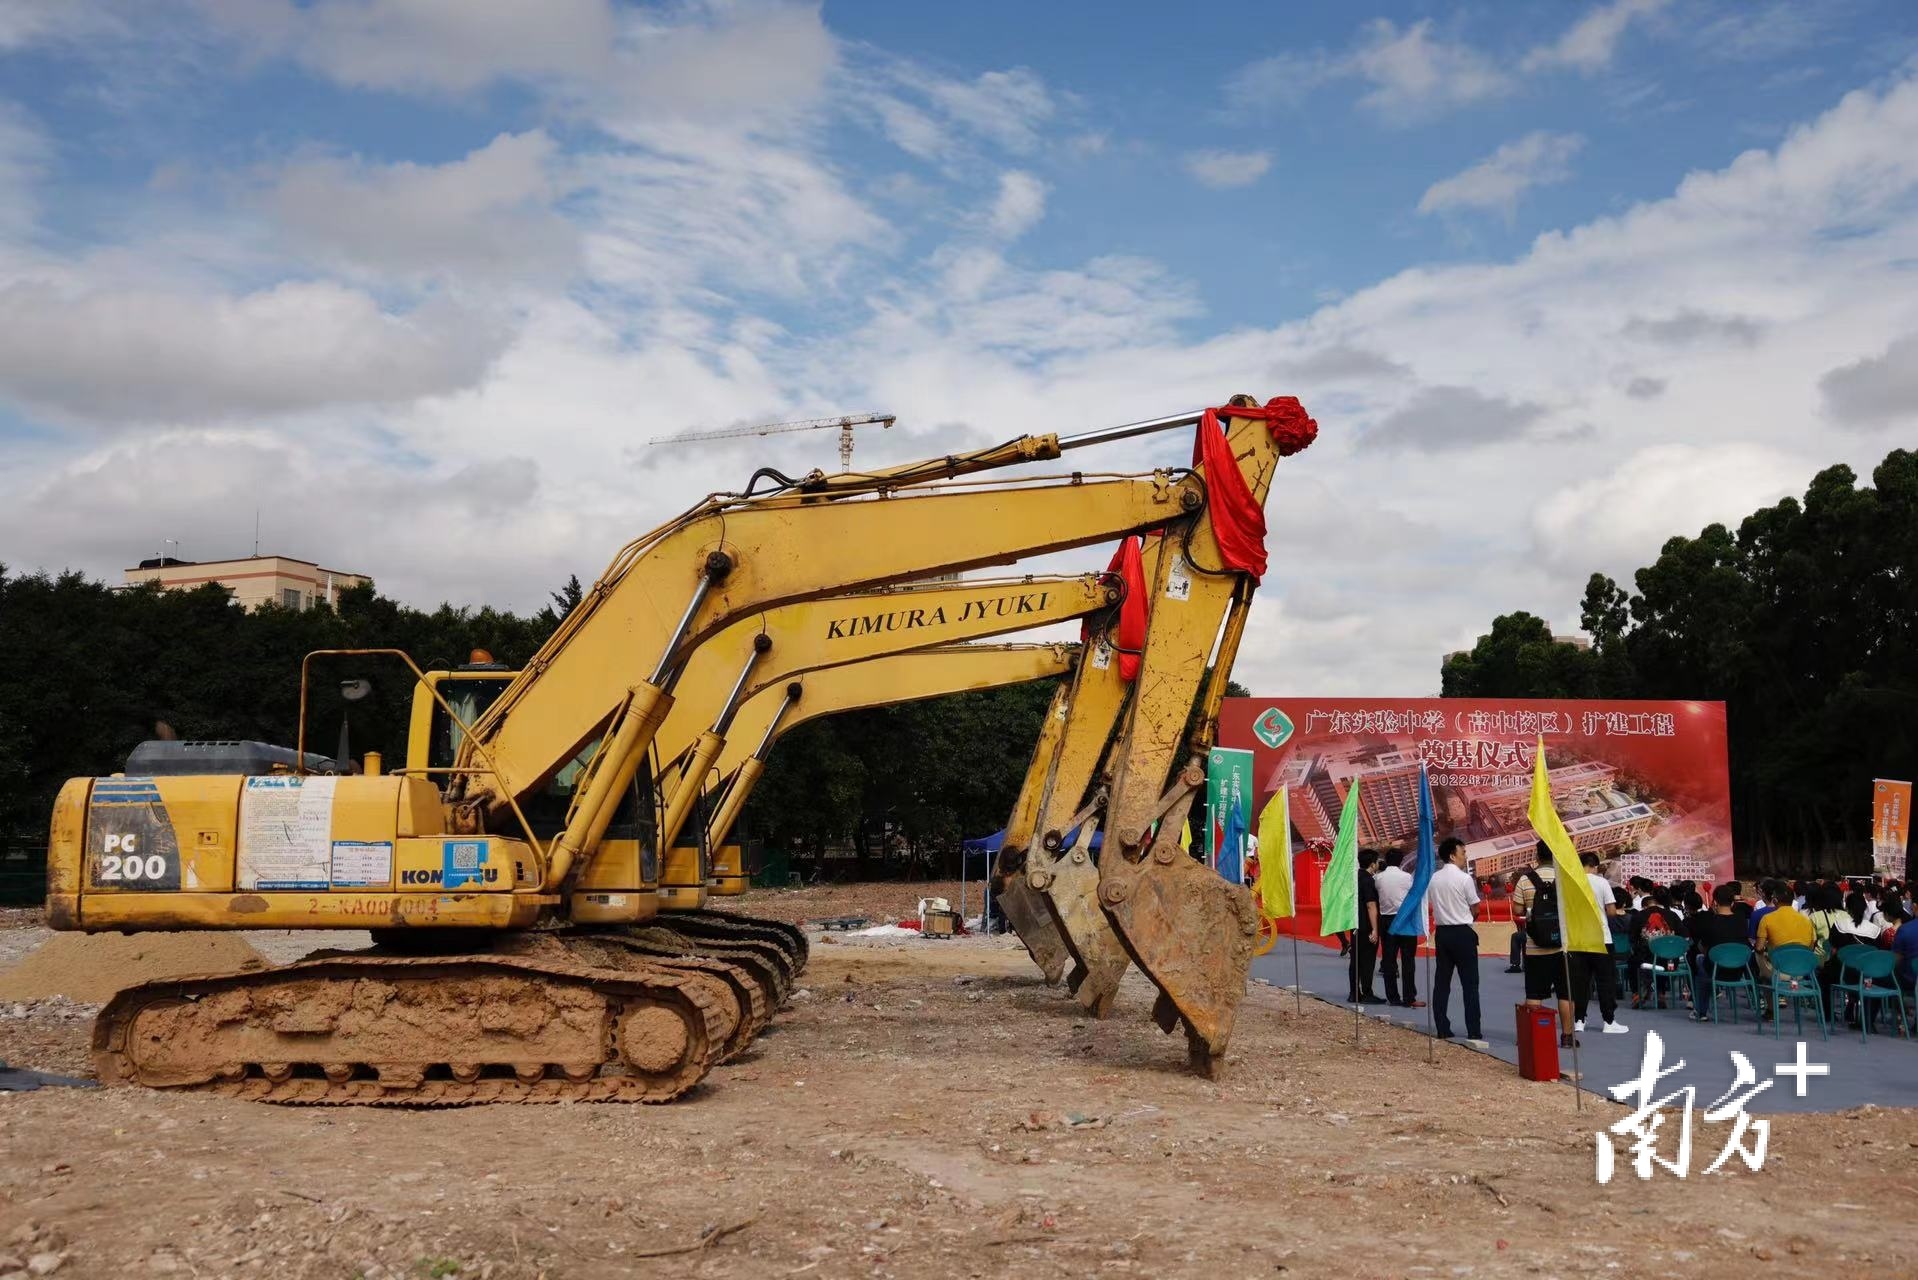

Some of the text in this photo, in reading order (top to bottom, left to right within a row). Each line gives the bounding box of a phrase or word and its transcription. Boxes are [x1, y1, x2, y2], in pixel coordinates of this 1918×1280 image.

[825, 592, 1049, 640] KIMURA JYUKI
[1419, 739, 1531, 770] 奠基仪式
[1430, 774, 1523, 786] 2022年7月1日
[104, 834, 136, 853] PC
[101, 855, 166, 880] 200
